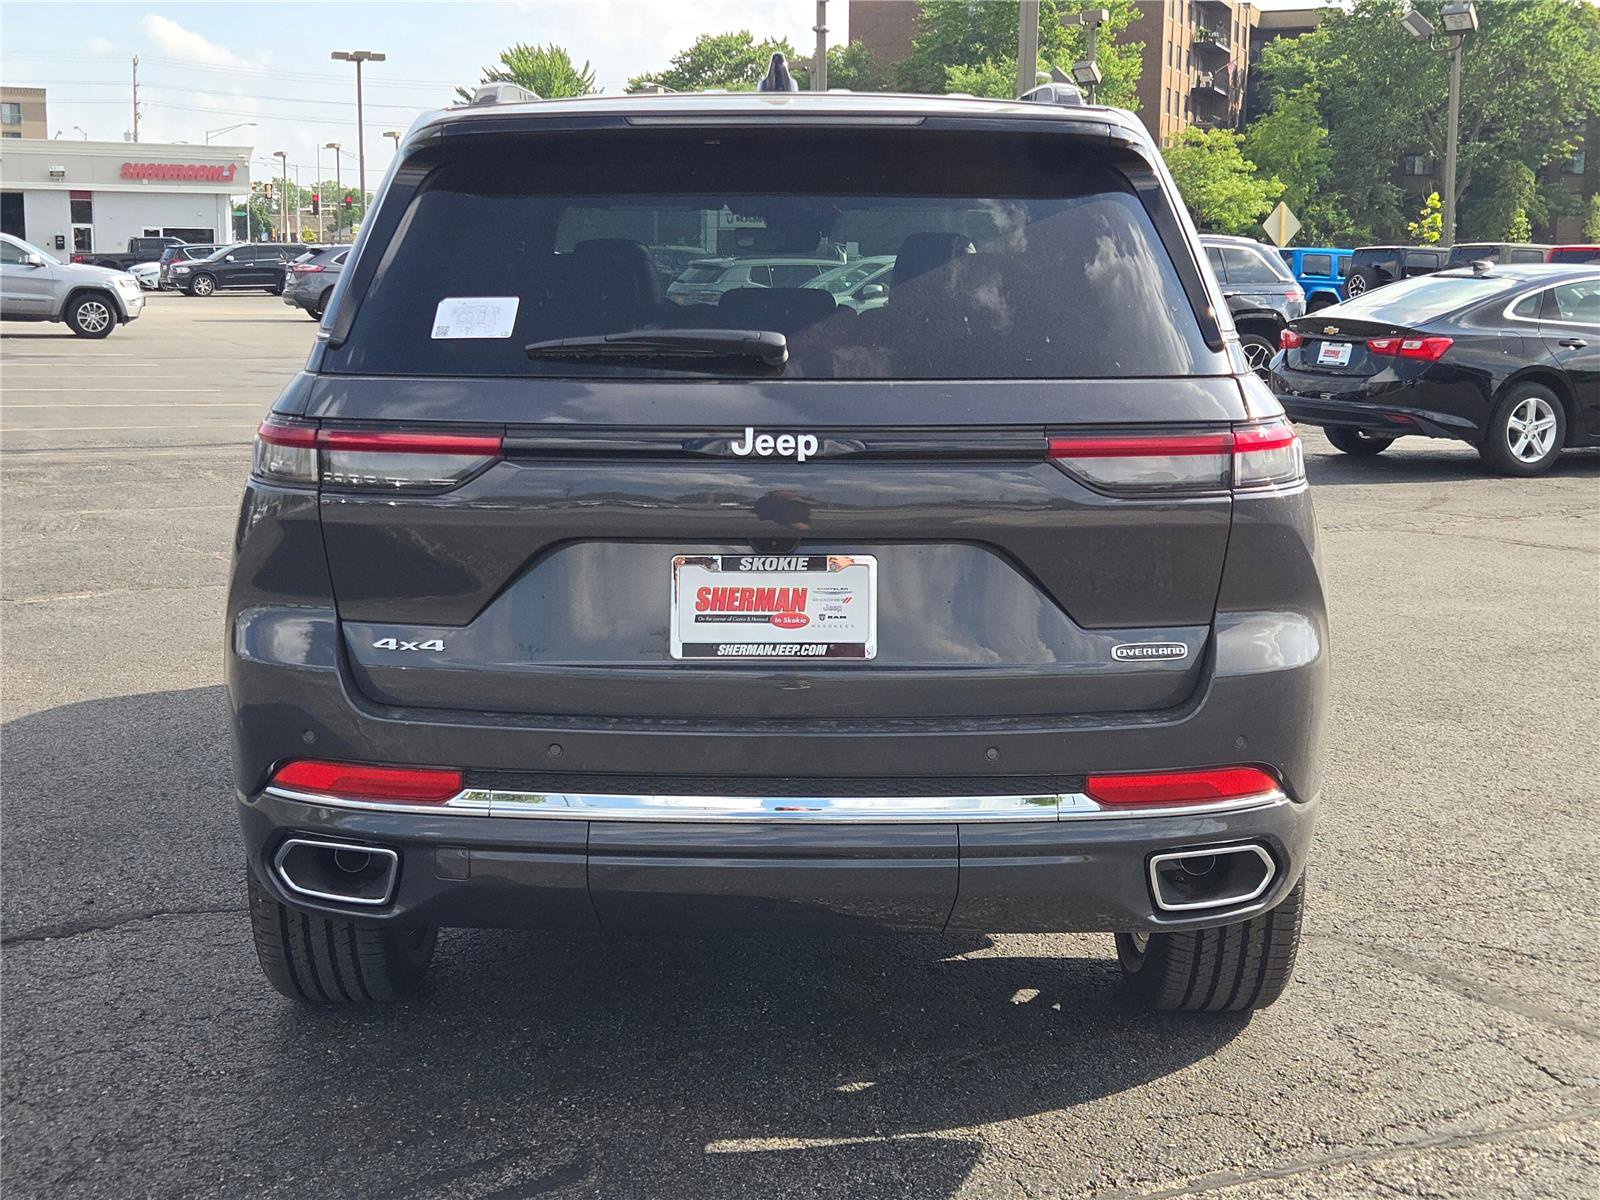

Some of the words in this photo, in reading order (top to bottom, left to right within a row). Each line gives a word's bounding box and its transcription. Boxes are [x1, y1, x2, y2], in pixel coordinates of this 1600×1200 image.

[120, 162, 225, 181] SHOWROOM
[731, 427, 818, 462] Jeep
[739, 557, 809, 571] SKOKIE
[695, 586, 808, 612] SHERMAN
[783, 616, 807, 624] Skokie
[372, 638, 446, 652] 4x4
[717, 644, 828, 656] SHERMANJEEP.COM
[1116, 647, 1185, 657] OVERLAND
